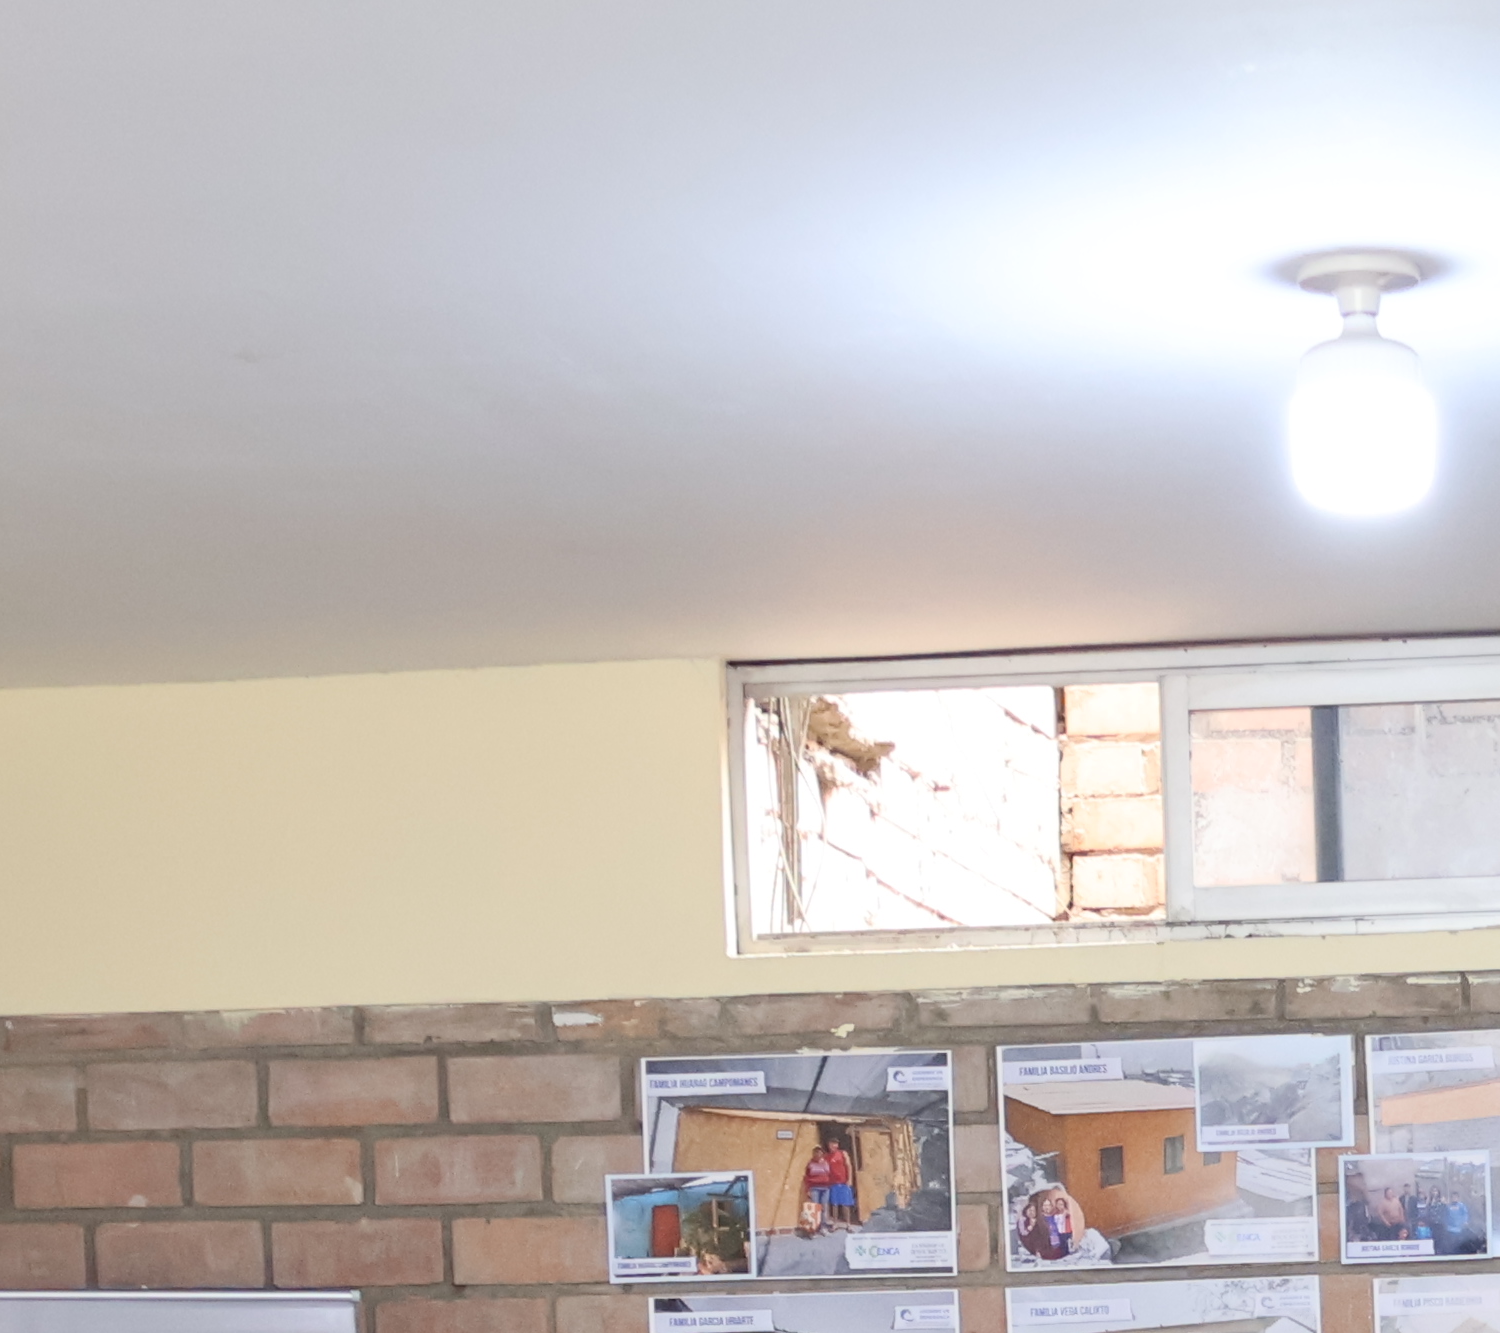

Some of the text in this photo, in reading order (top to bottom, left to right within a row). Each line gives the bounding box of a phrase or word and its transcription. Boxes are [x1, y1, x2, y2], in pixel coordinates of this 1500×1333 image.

[1019, 1066, 1048, 1077] FAMILIA
[1078, 1063, 1108, 1075] ANDRES
[1030, 1308, 1059, 1318] FAMILIA
[1061, 1306, 1078, 1316] VEGA
[669, 1317, 697, 1327] FAMILIA
